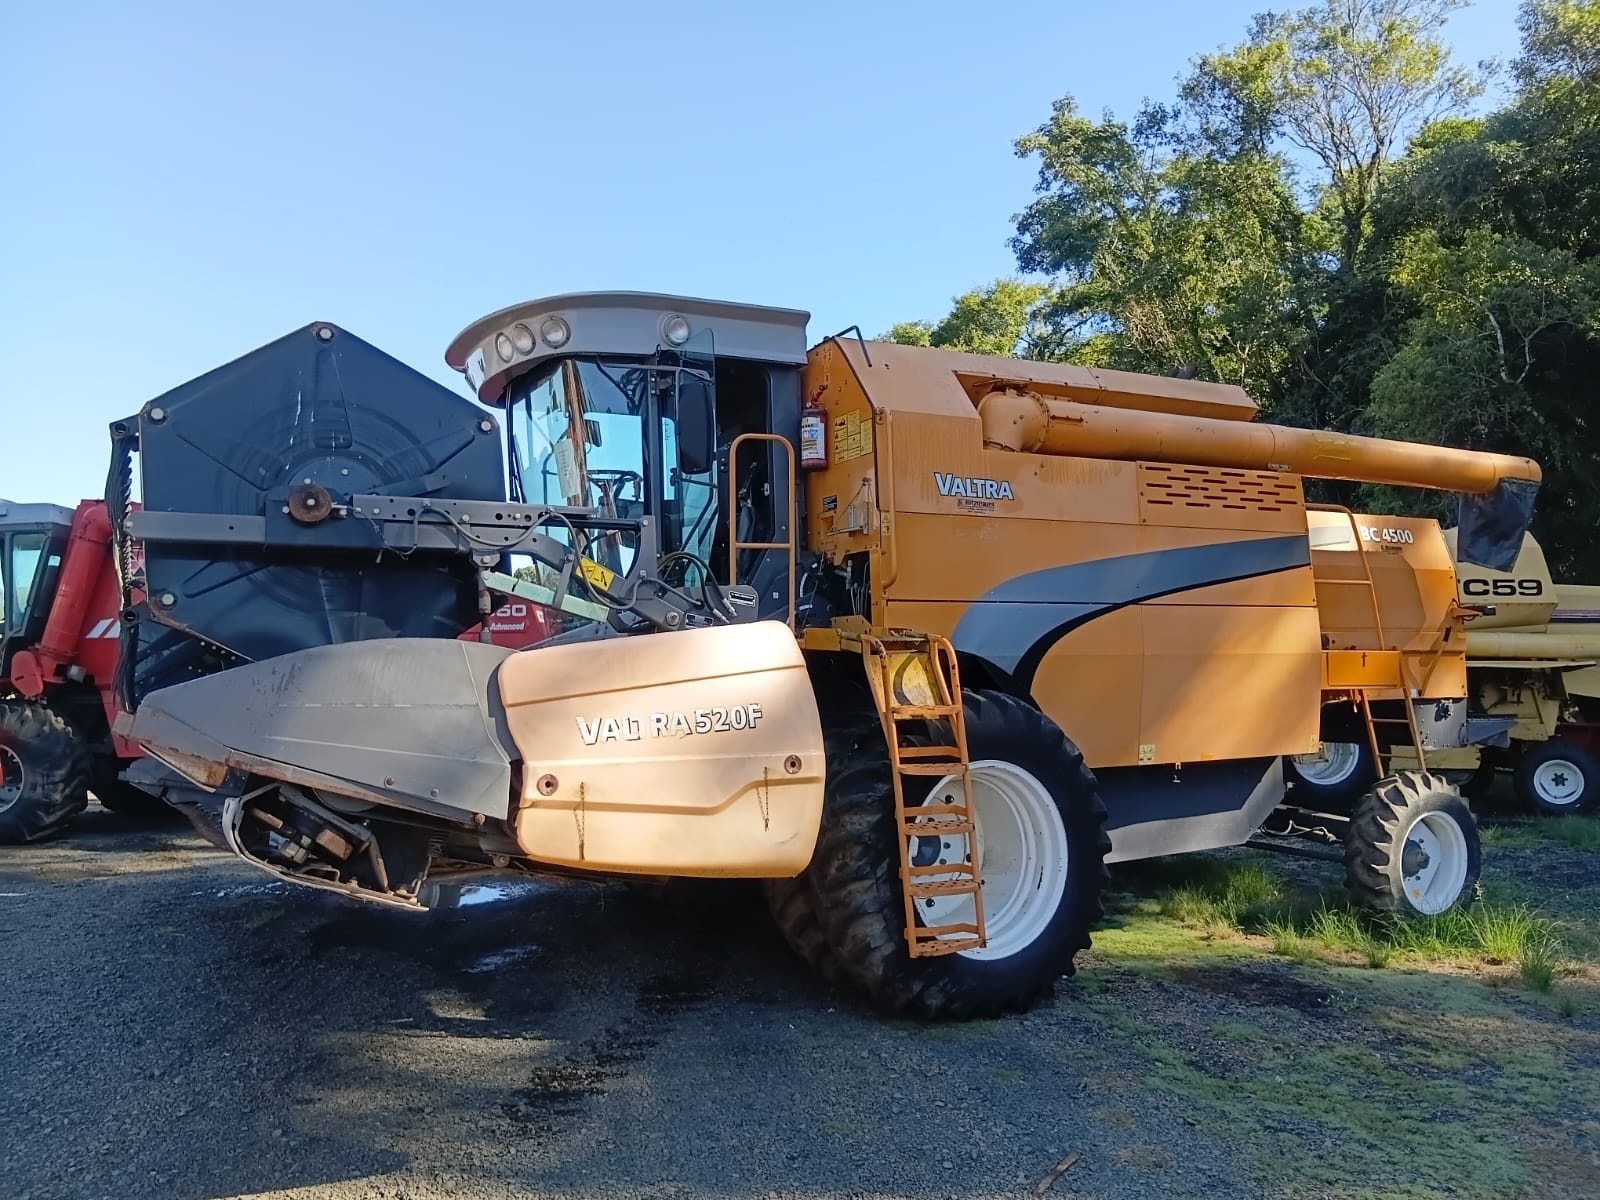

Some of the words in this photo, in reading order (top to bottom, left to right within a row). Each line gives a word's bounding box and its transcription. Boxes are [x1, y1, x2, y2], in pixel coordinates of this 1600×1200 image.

[934, 472, 1014, 500] VALTRA
[1359, 526, 1380, 542] BC
[1382, 528, 1414, 544] 4500
[1463, 579, 1542, 596] C59
[490, 622, 525, 631] Advanced
[694, 703, 763, 735] 520F
